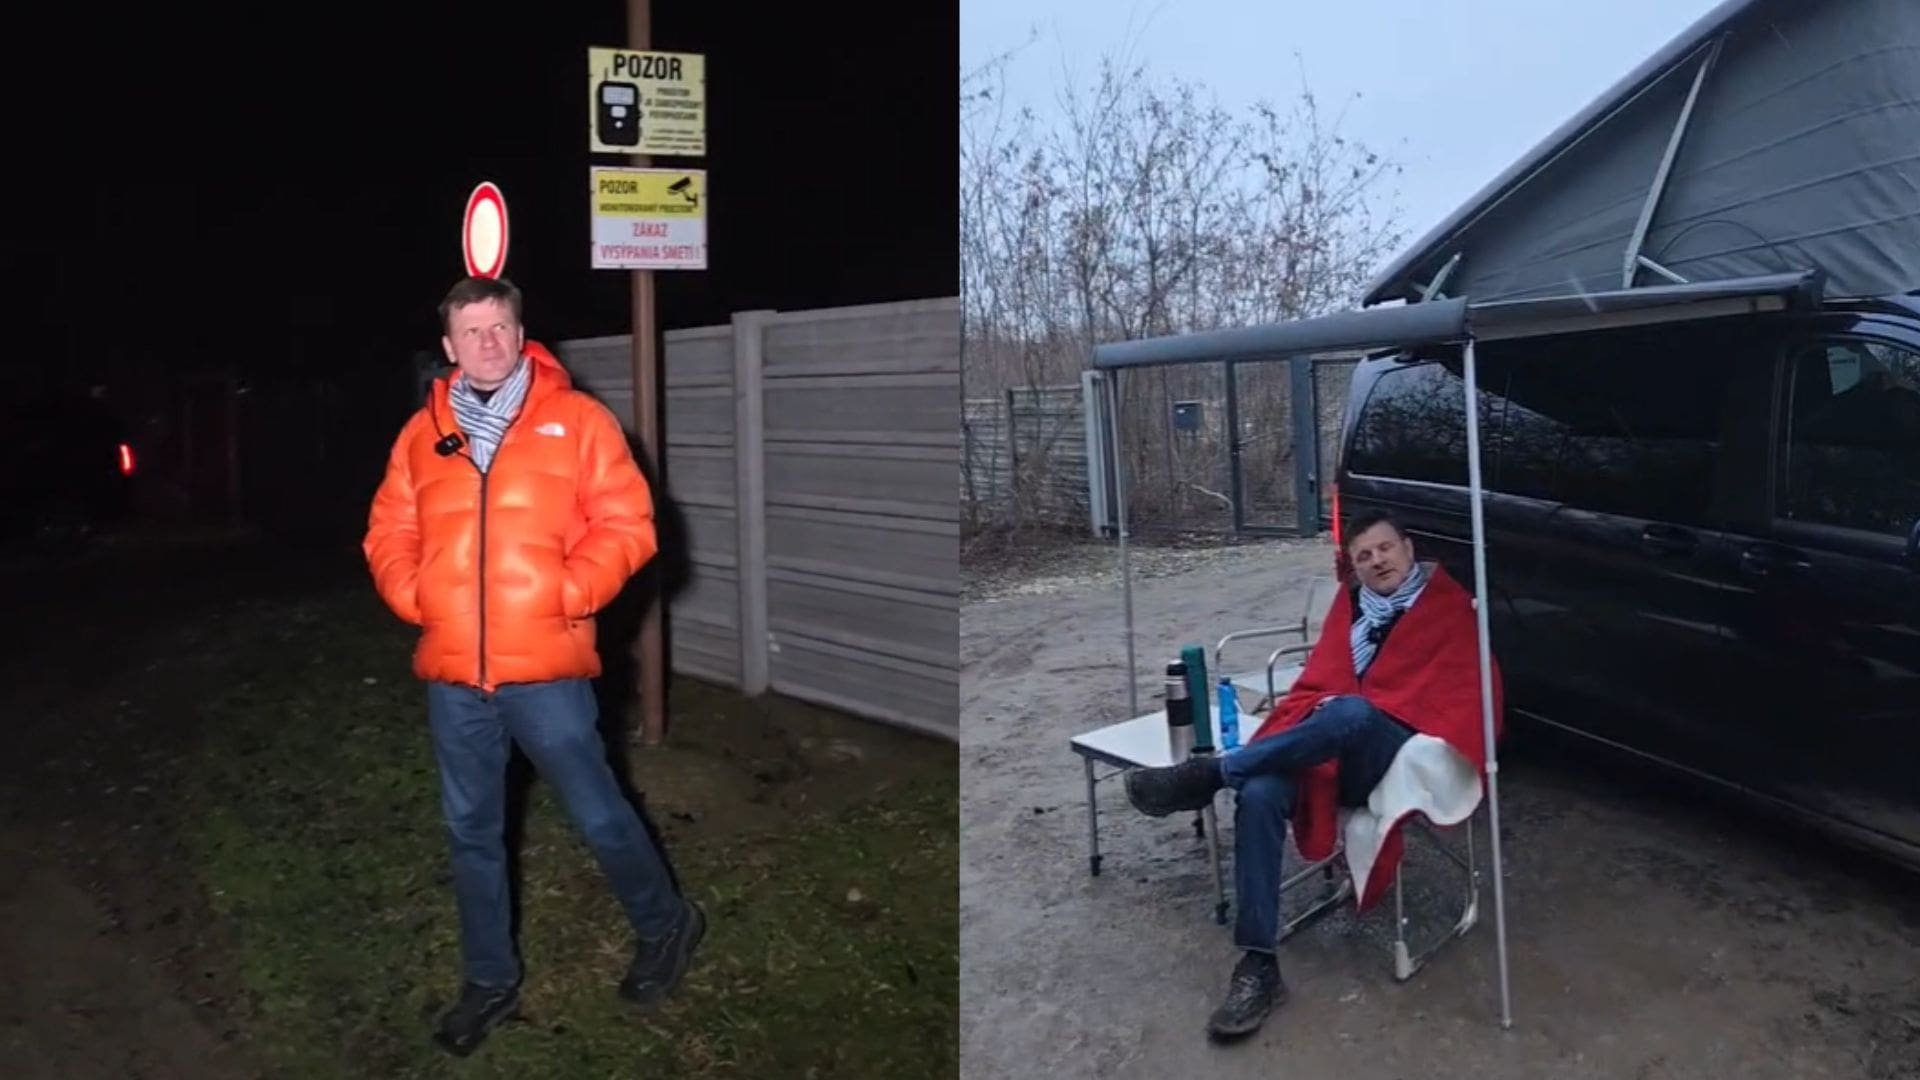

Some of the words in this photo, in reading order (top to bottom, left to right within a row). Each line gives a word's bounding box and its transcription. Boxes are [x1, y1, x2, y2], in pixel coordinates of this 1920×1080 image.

[613, 53, 682, 80] POZOR
[599, 180, 638, 194] POZOR
[632, 222, 668, 237] ZÁKAZ
